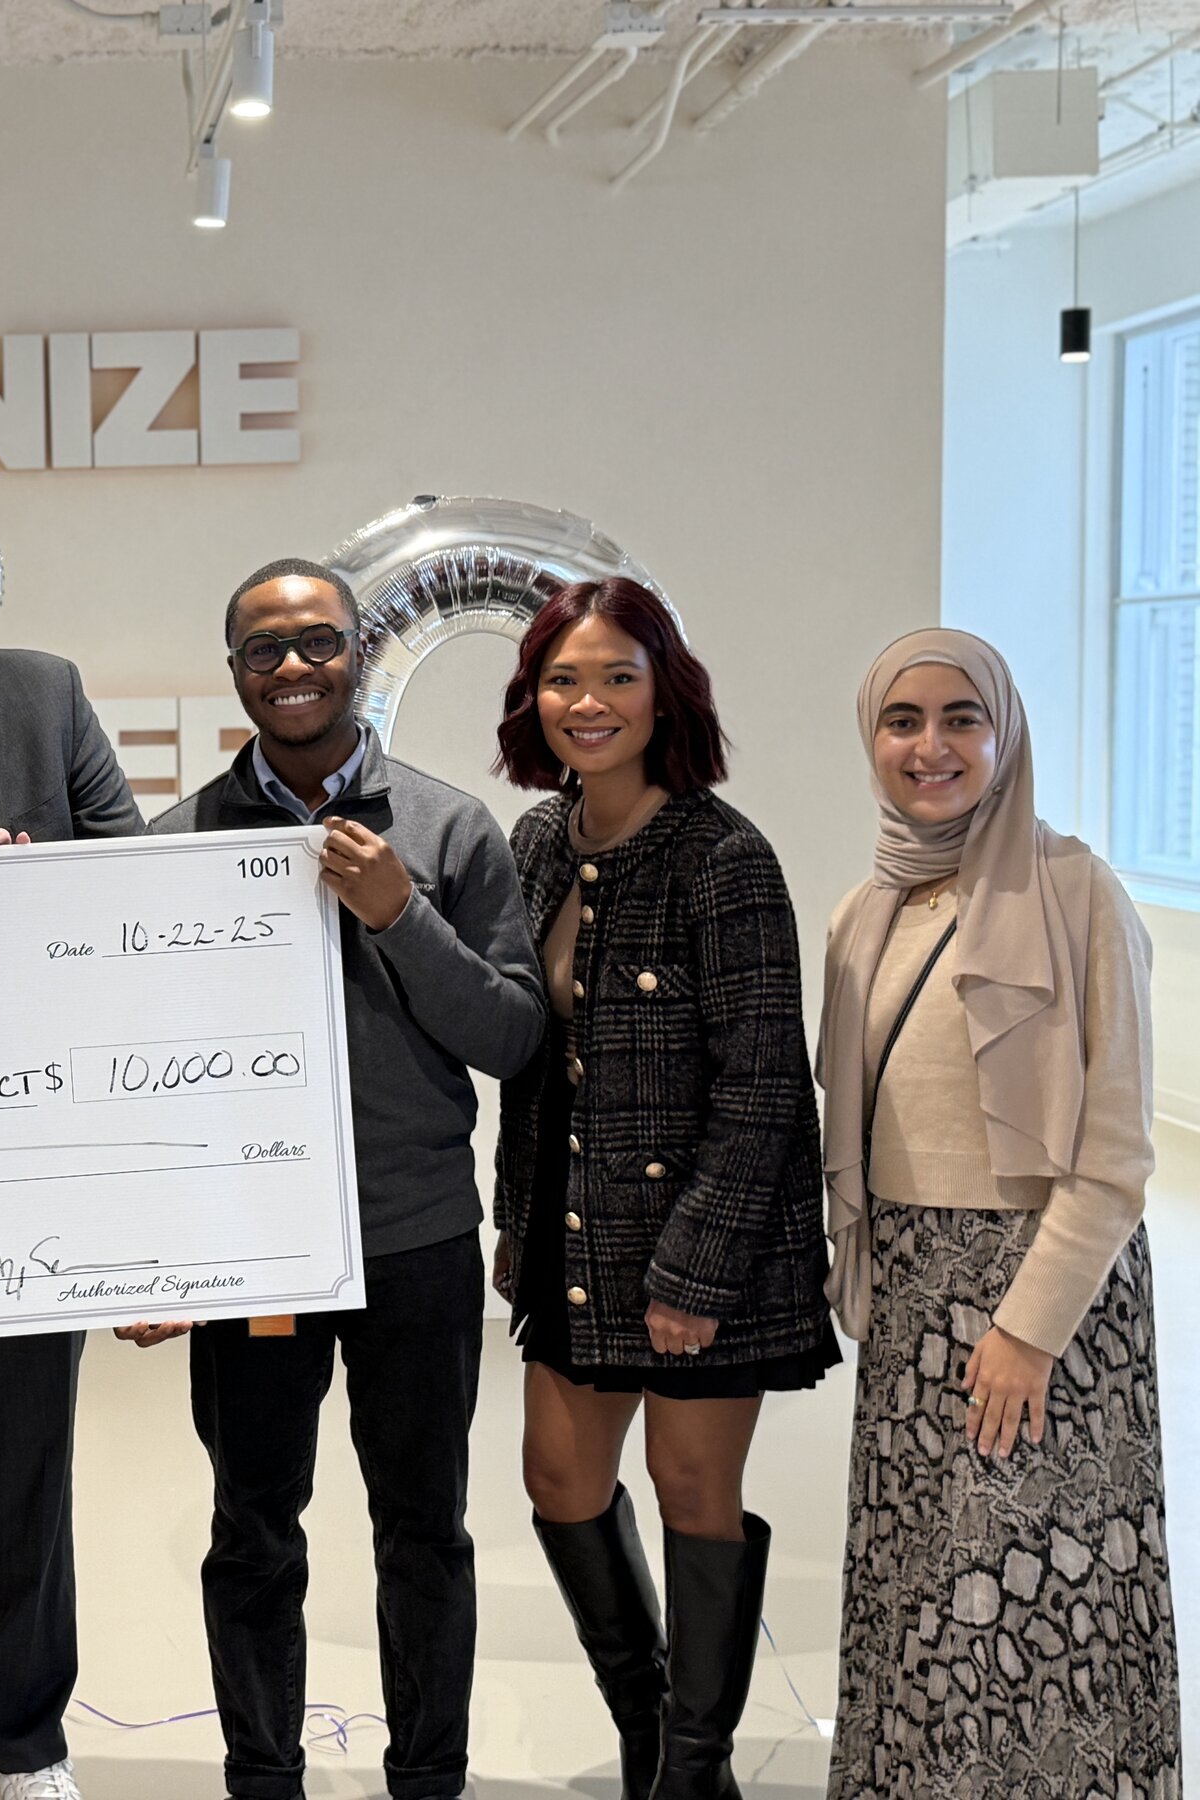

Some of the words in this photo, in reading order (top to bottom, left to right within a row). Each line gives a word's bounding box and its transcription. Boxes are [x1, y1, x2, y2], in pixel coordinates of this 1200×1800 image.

[236, 855, 291, 879] 1001
[121, 912, 292, 953] 10-22-25
[46, 940, 95, 960] Date
[108, 1049, 301, 1096] 10,000.00
[241, 1141, 306, 1161] Dollars
[56, 1275, 160, 1303] Authorized
[161, 1273, 246, 1299] Signature
